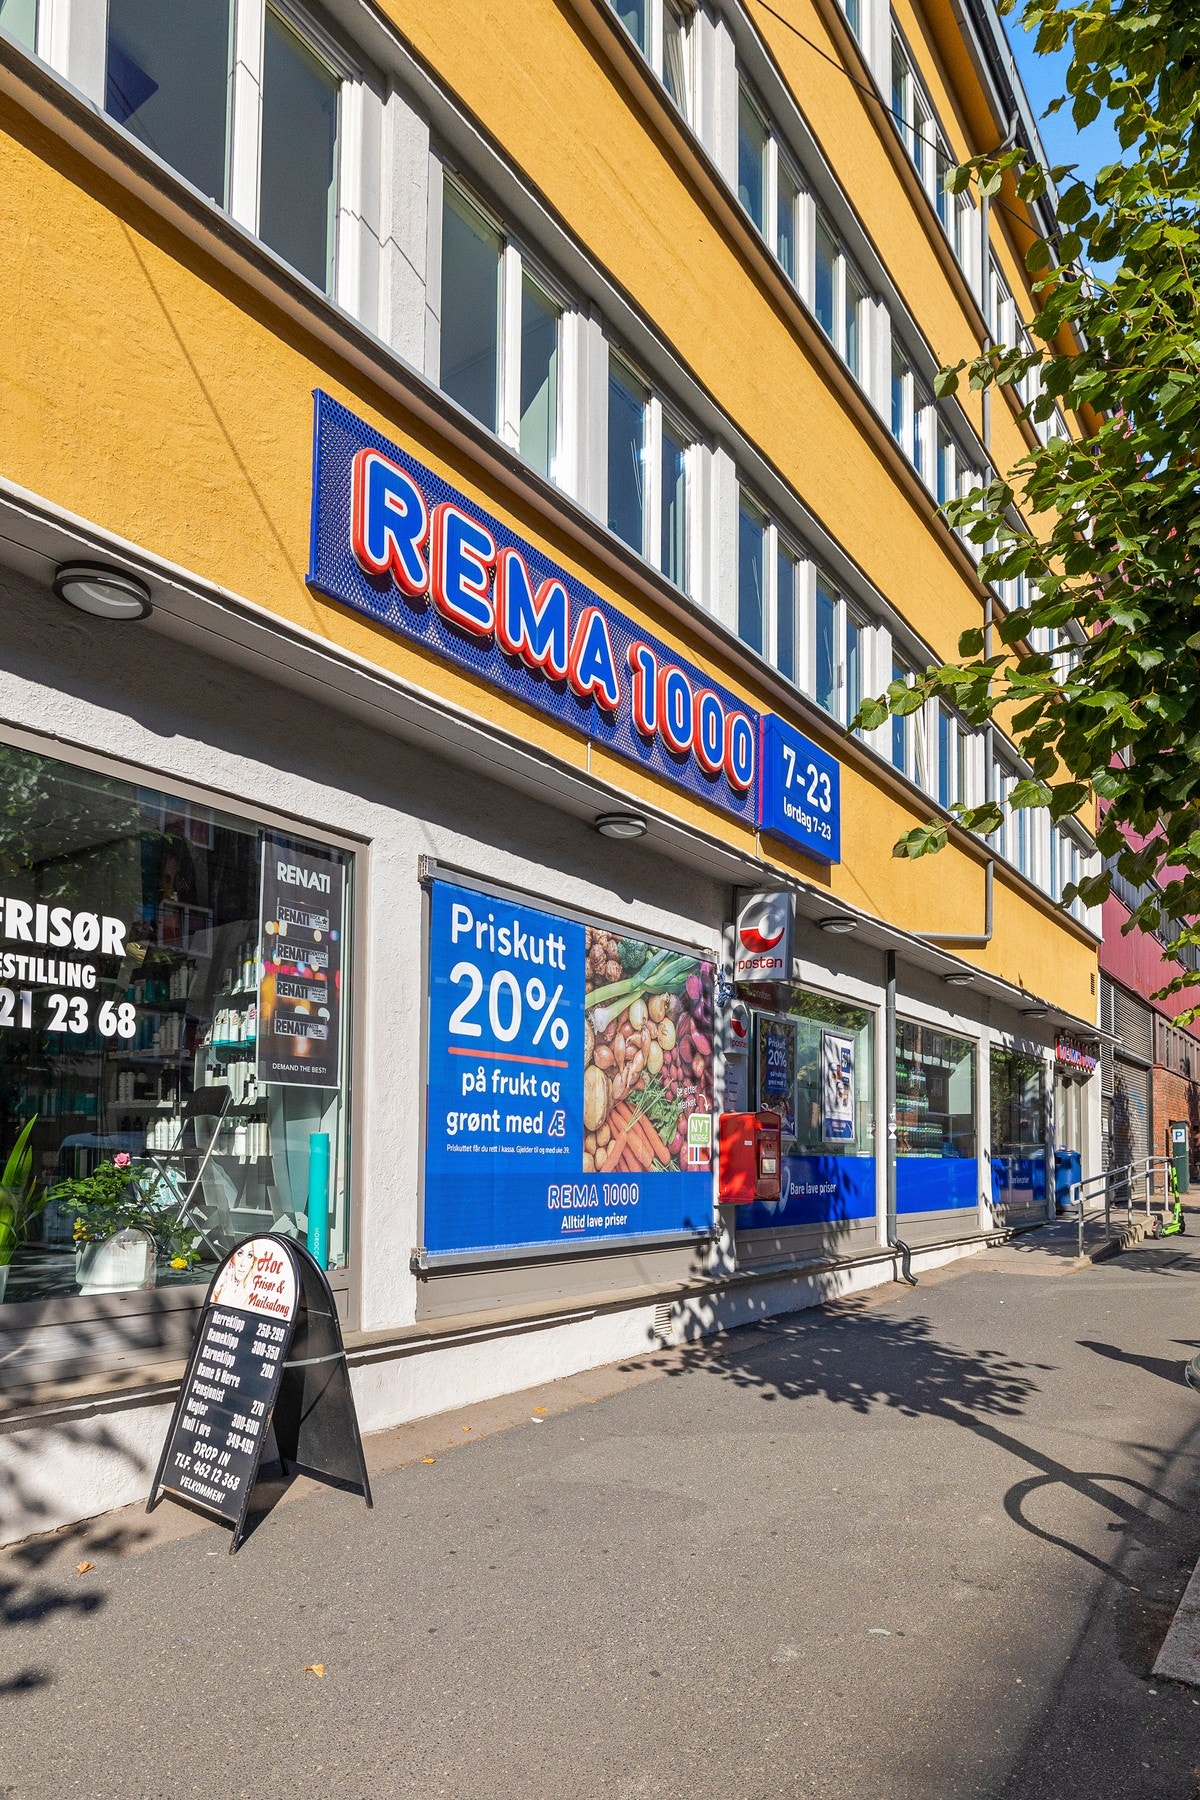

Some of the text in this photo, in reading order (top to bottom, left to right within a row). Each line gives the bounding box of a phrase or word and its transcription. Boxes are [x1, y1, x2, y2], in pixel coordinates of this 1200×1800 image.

[351, 447, 755, 791] REMA 1000
[783, 744, 831, 813] 7-23
[783, 796, 832, 841] lørdag 7-23
[277, 861, 331, 894] RENATI
[0, 896, 126, 957] RISØR
[278, 906, 310, 926] RENATI
[451, 903, 566, 971] Priskutt
[277, 943, 310, 963] RENATI
[738, 957, 783, 973] posten
[0, 952, 96, 990] STILLING
[276, 981, 308, 999] RENATI
[47, 993, 89, 1034] 23
[98, 1000, 137, 1039] 68
[449, 961, 570, 1051] 20%
[275, 1019, 308, 1036] RENATI
[272, 1062, 327, 1074] DEMAND THE BEST!
[767, 1049, 788, 1067] 20%
[462, 1066, 560, 1103] på frukt og
[684, 1085, 698, 1095] etter
[446, 1109, 566, 1137] grønt med Æ
[691, 1119, 709, 1133] NYT
[1175, 1131, 1183, 1141] P
[446, 1143, 472, 1152] Priskuttet
[472, 1144, 480, 1152] får
[480, 1144, 488, 1152] du
[488, 1145, 498, 1153] rett
[545, 1146, 556, 1154] med
[548, 1183, 639, 1210] REMA 1000
[790, 1181, 837, 1196] Bare lave priser
[561, 1213, 628, 1231] Alltid lave priser
[257, 1251, 284, 1275] Hoc
[253, 1274, 285, 1294] Frisør &
[248, 1293, 290, 1318] Nailsalong
[212, 1310, 286, 1343] Herreklipp 250-299
[207, 1327, 281, 1361] Dameklipp 300-350
[202, 1344, 275, 1379] Barneklipp 200
[196, 1362, 241, 1388] Dame & Herre
[191, 1380, 265, 1417] Pensjonist 270
[182, 1415, 211, 1438] Hull i øre
[186, 1398, 260, 1436] Negler 300-600
[193, 1441, 231, 1467] DROP IN
[226, 1431, 255, 1455] 349-499
[174, 1452, 240, 1491] TLF. 462 12 368
[180, 1475, 226, 1503] VELKOMMEN!
